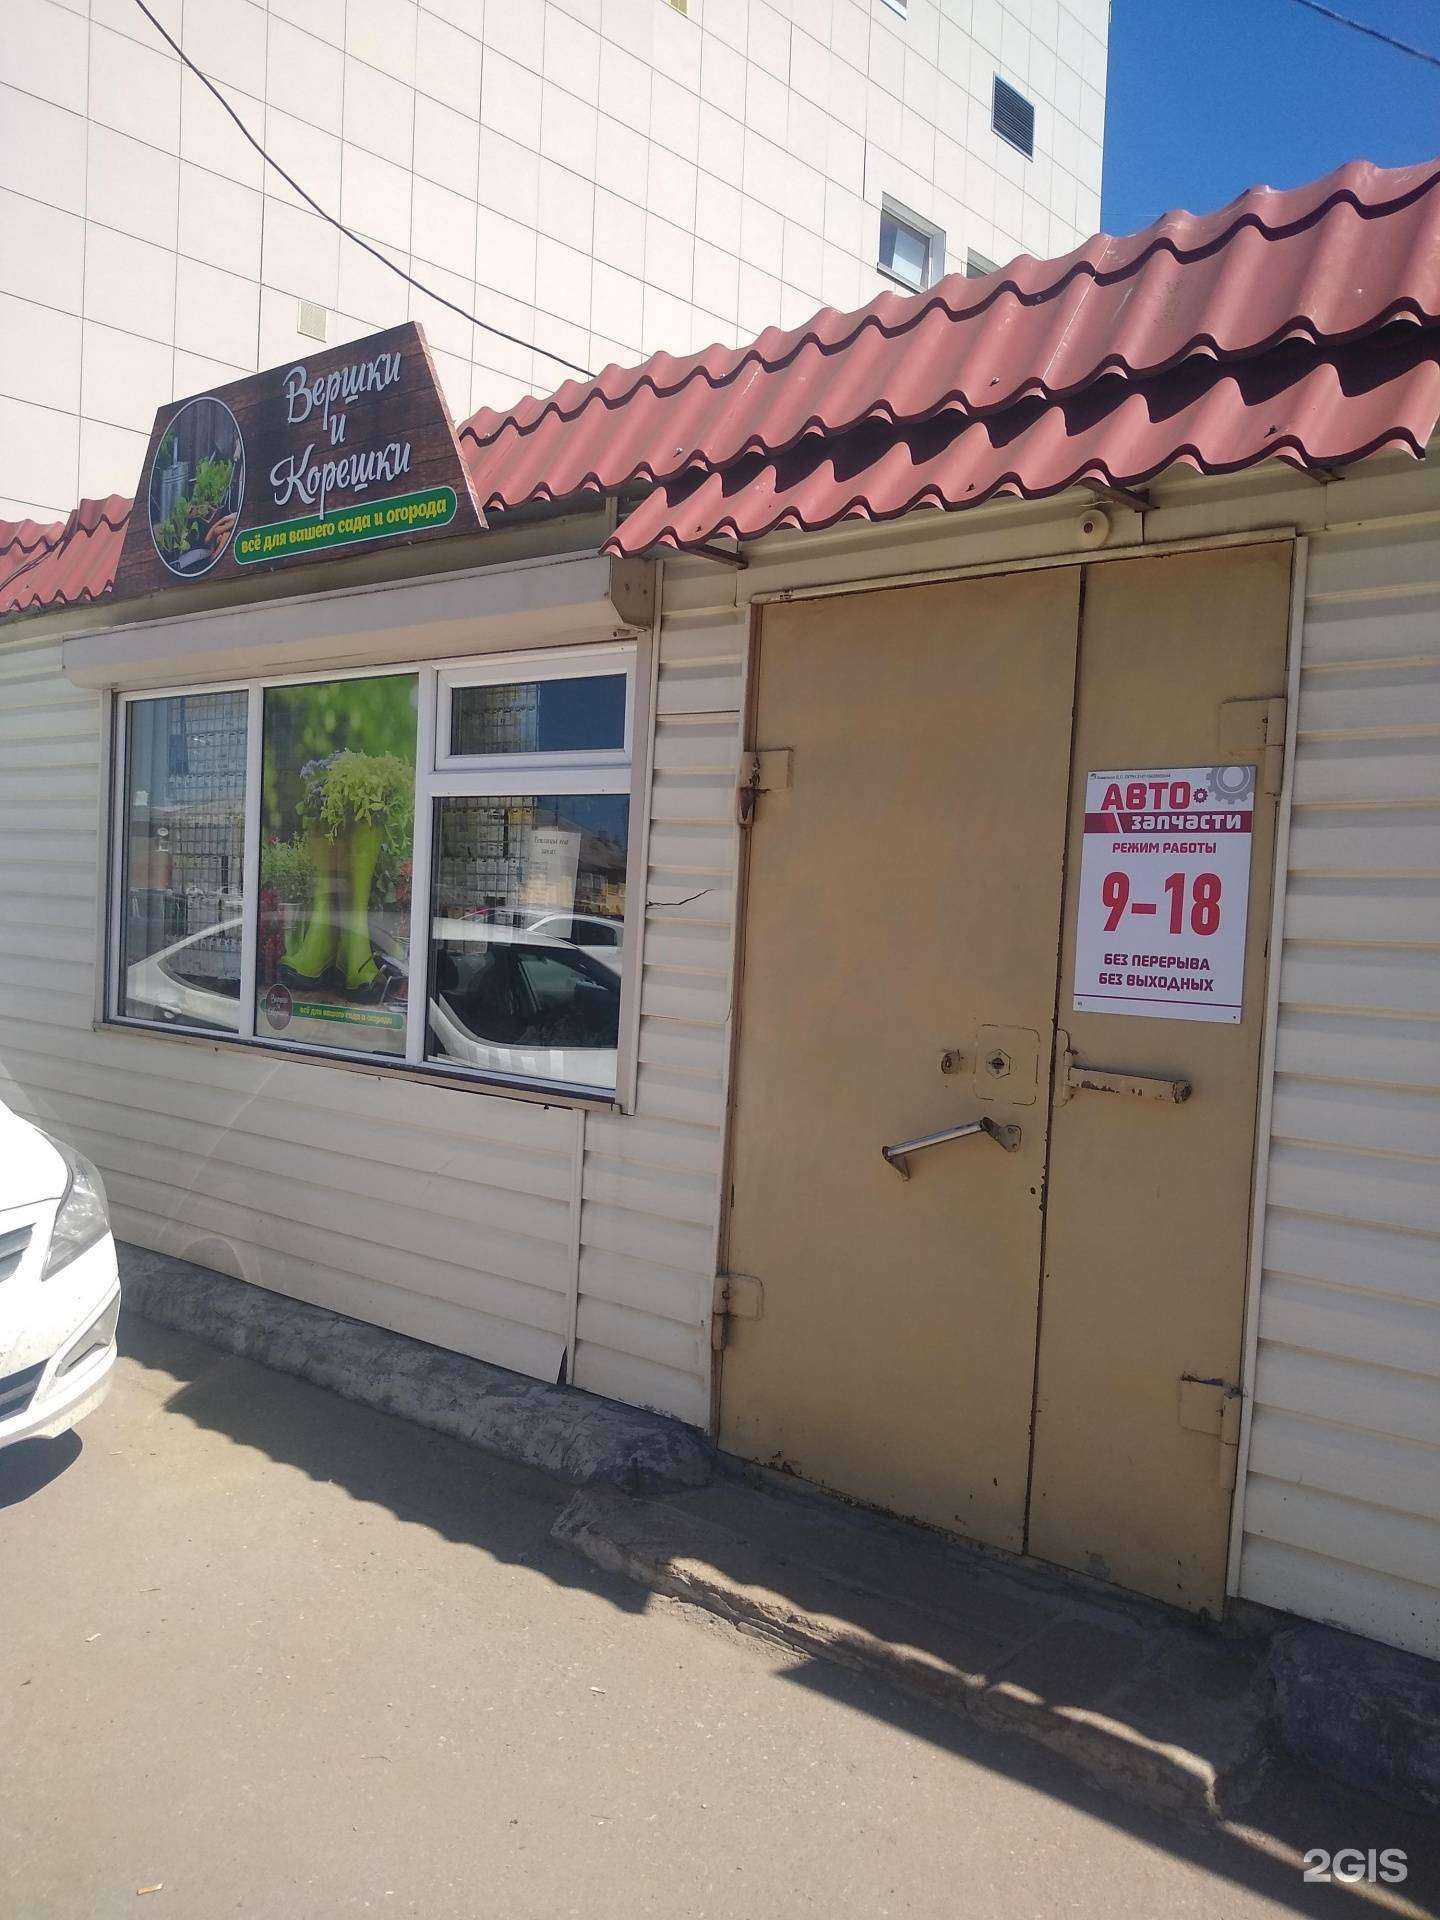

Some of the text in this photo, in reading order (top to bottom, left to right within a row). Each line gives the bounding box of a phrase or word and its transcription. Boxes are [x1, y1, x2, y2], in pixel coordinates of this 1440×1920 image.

[283, 351, 401, 431] Вершки
[329, 413, 347, 445] и
[270, 442, 411, 520] Корешки
[241, 498, 448, 554] всё для вашего сада и огорода
[1101, 781, 1192, 811] АВТО
[1112, 842, 1217, 854] РЕЖИМ РАБОТЫ
[1103, 953, 1211, 971] БЕЗ ПЕРЕРЫВА
[1098, 972, 1214, 992] БЕЗ ВЫХОДНЫХ
